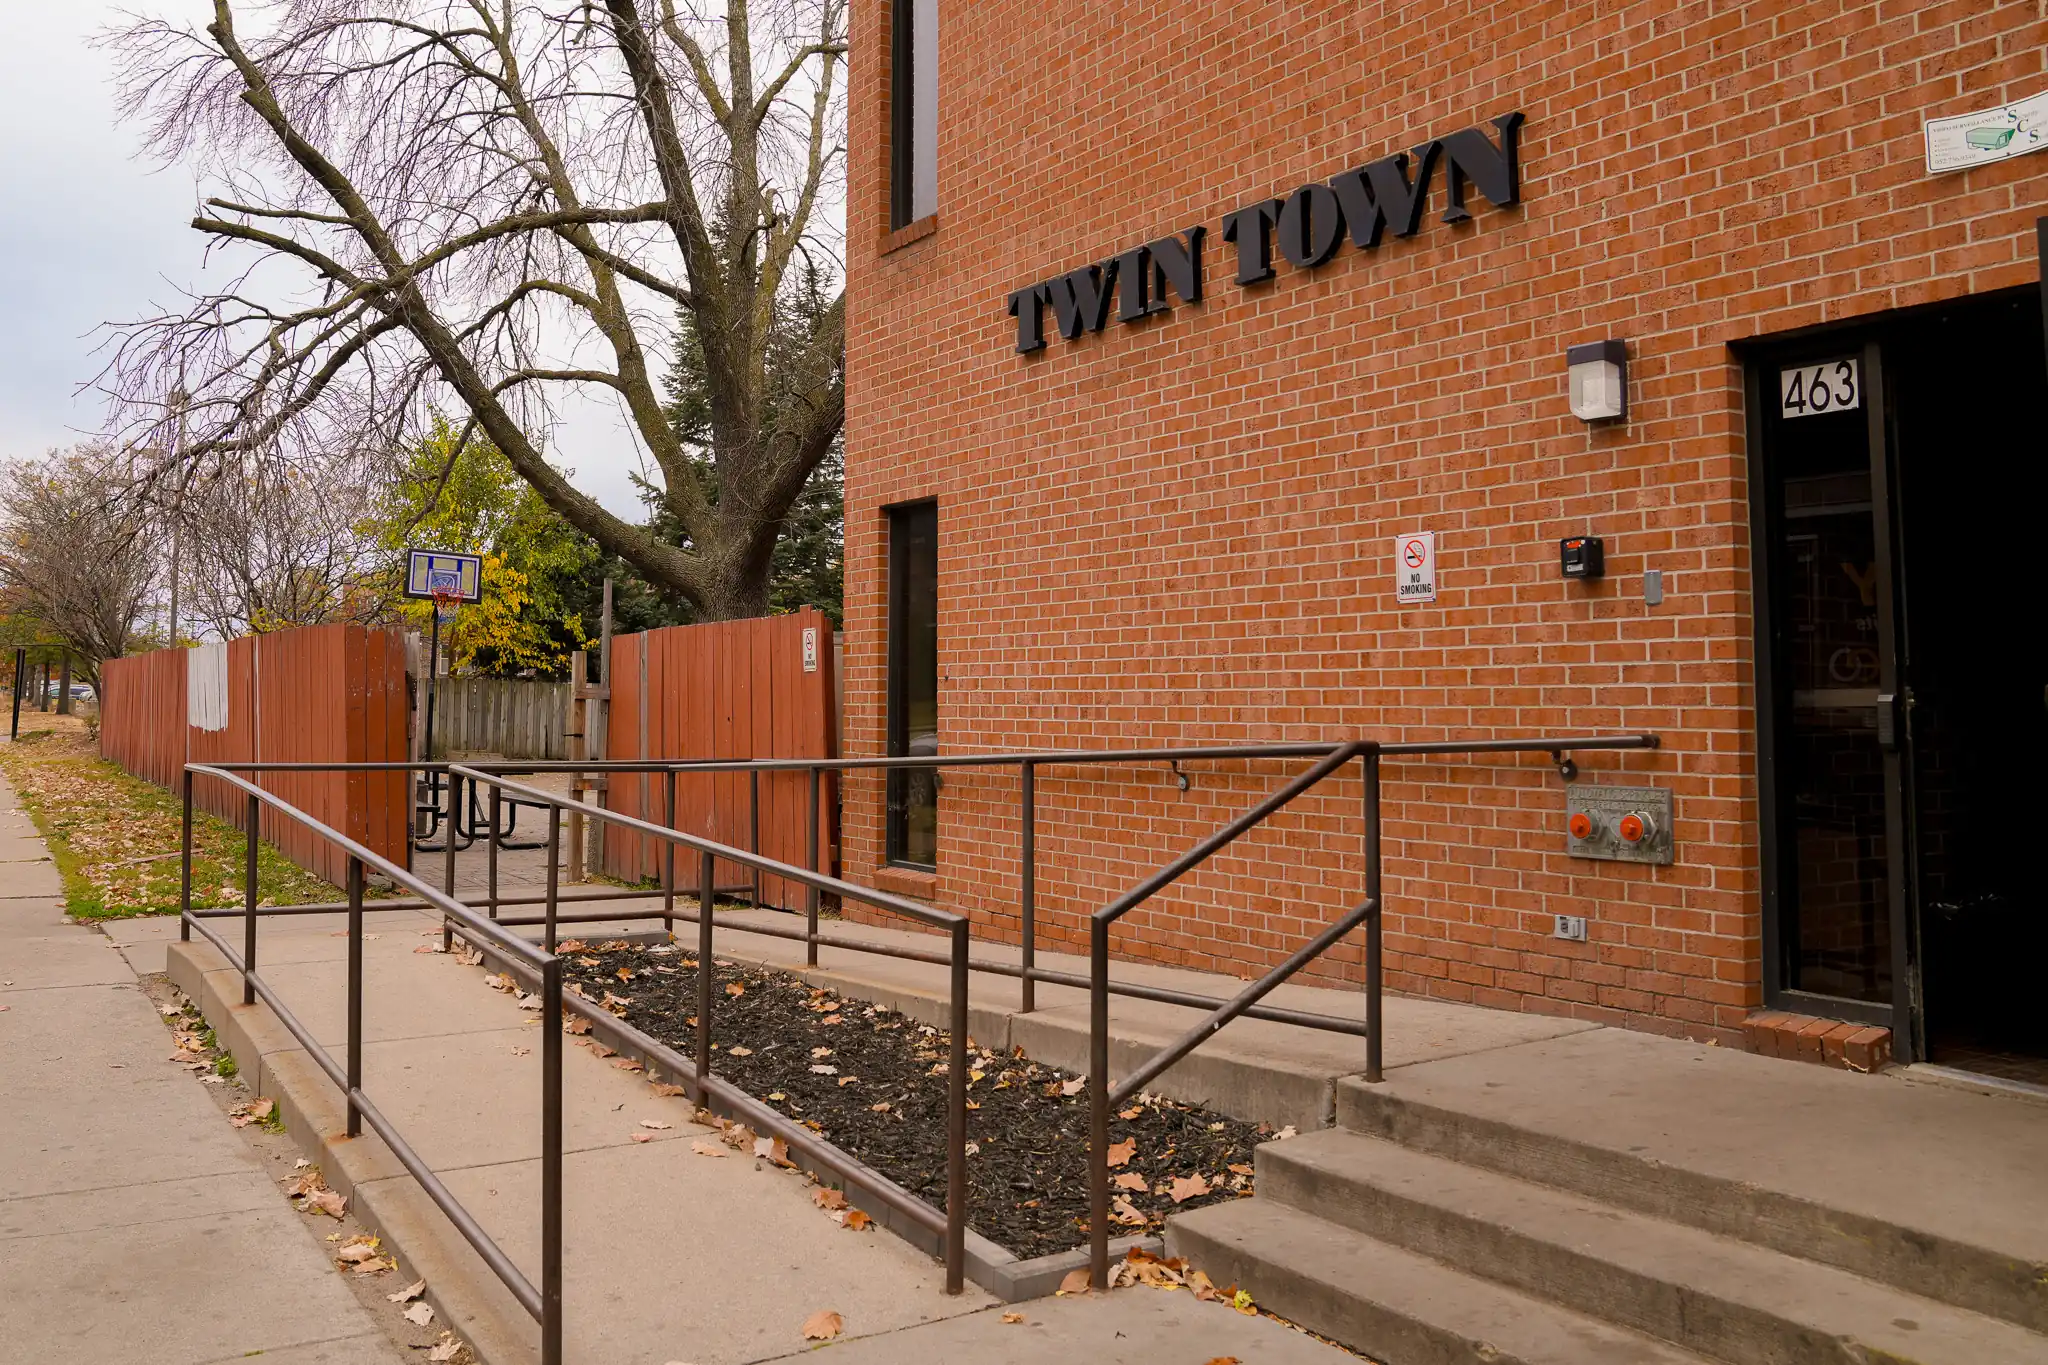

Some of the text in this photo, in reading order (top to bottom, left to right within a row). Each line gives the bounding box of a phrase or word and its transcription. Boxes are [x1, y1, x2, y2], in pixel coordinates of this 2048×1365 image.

[1007, 112, 1525, 354] TWIN TOWN
[1784, 361, 1854, 413] 463
[1400, 583, 1432, 595] SMOKING
[1411, 573, 1420, 583] NO
